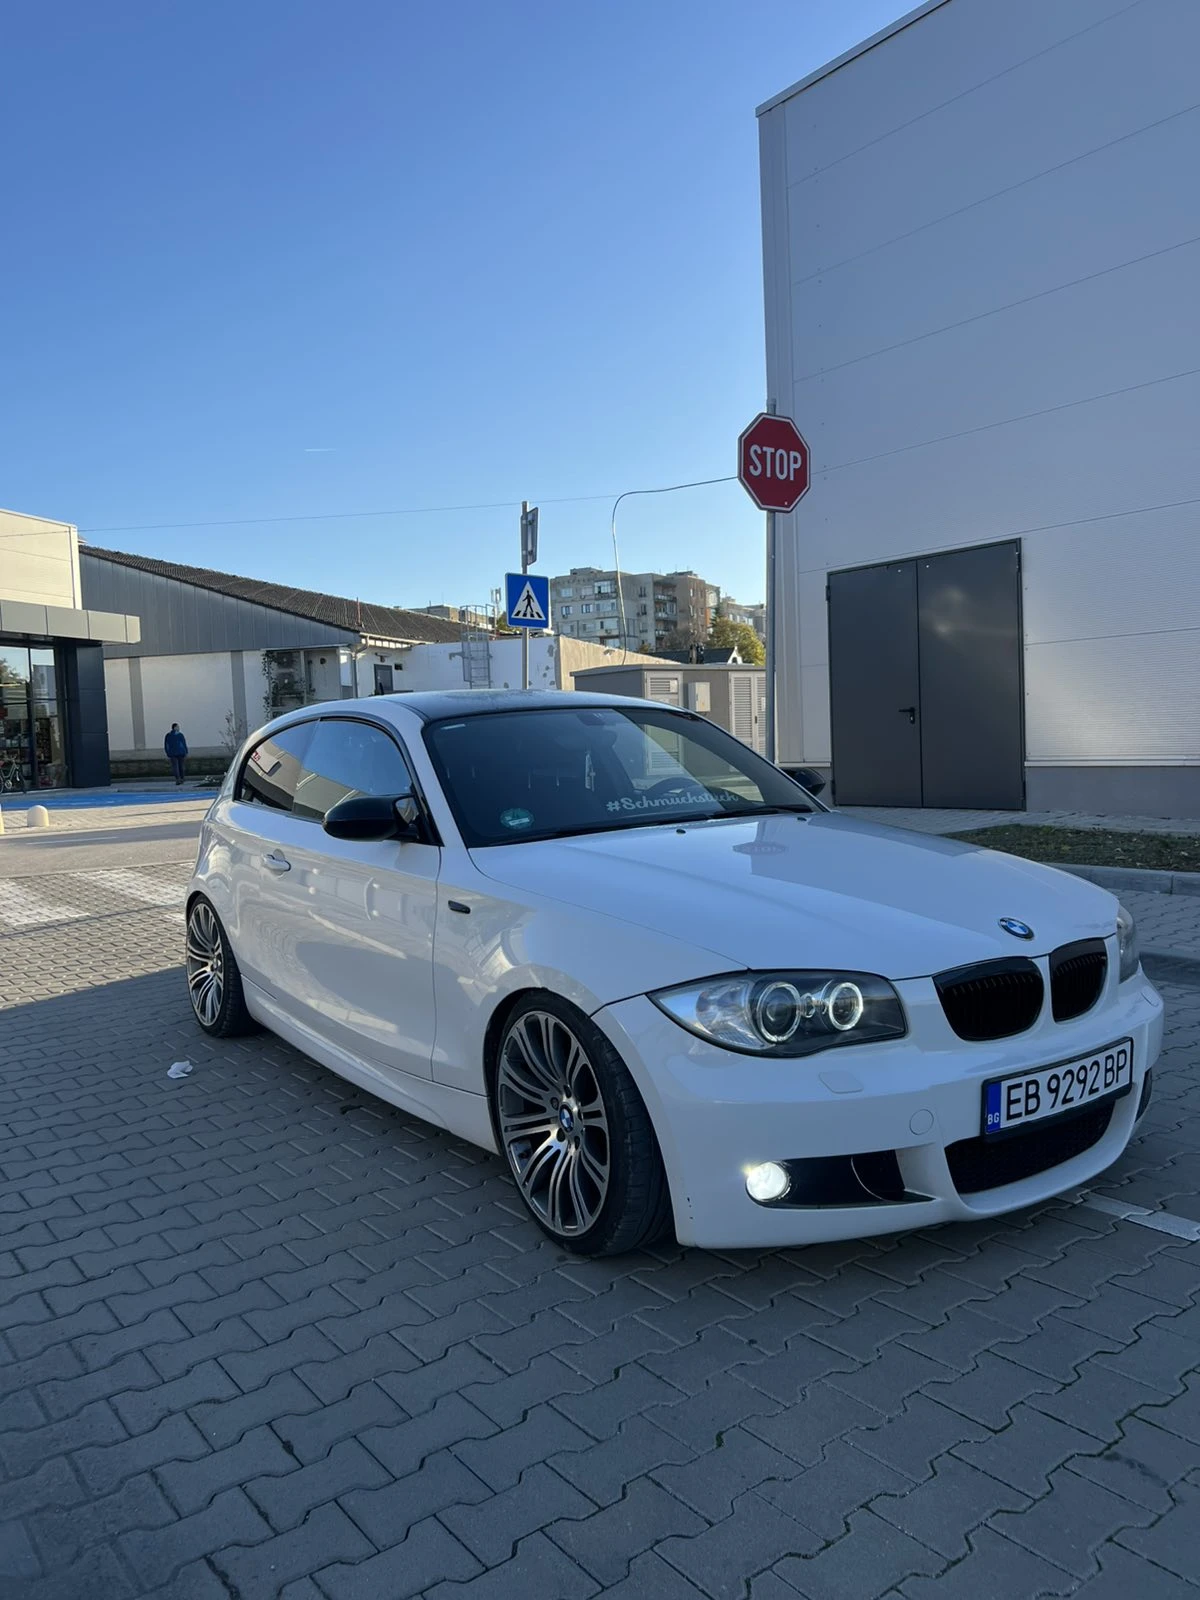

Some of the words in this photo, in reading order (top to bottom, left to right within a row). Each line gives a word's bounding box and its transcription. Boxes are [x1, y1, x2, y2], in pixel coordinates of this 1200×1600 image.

[749, 444, 802, 481] STOP
[1006, 1079, 1040, 1121] EB
[1047, 1060, 1100, 1109] 9292
[1104, 1049, 1127, 1089] BP
[987, 1112, 1000, 1126] BG
